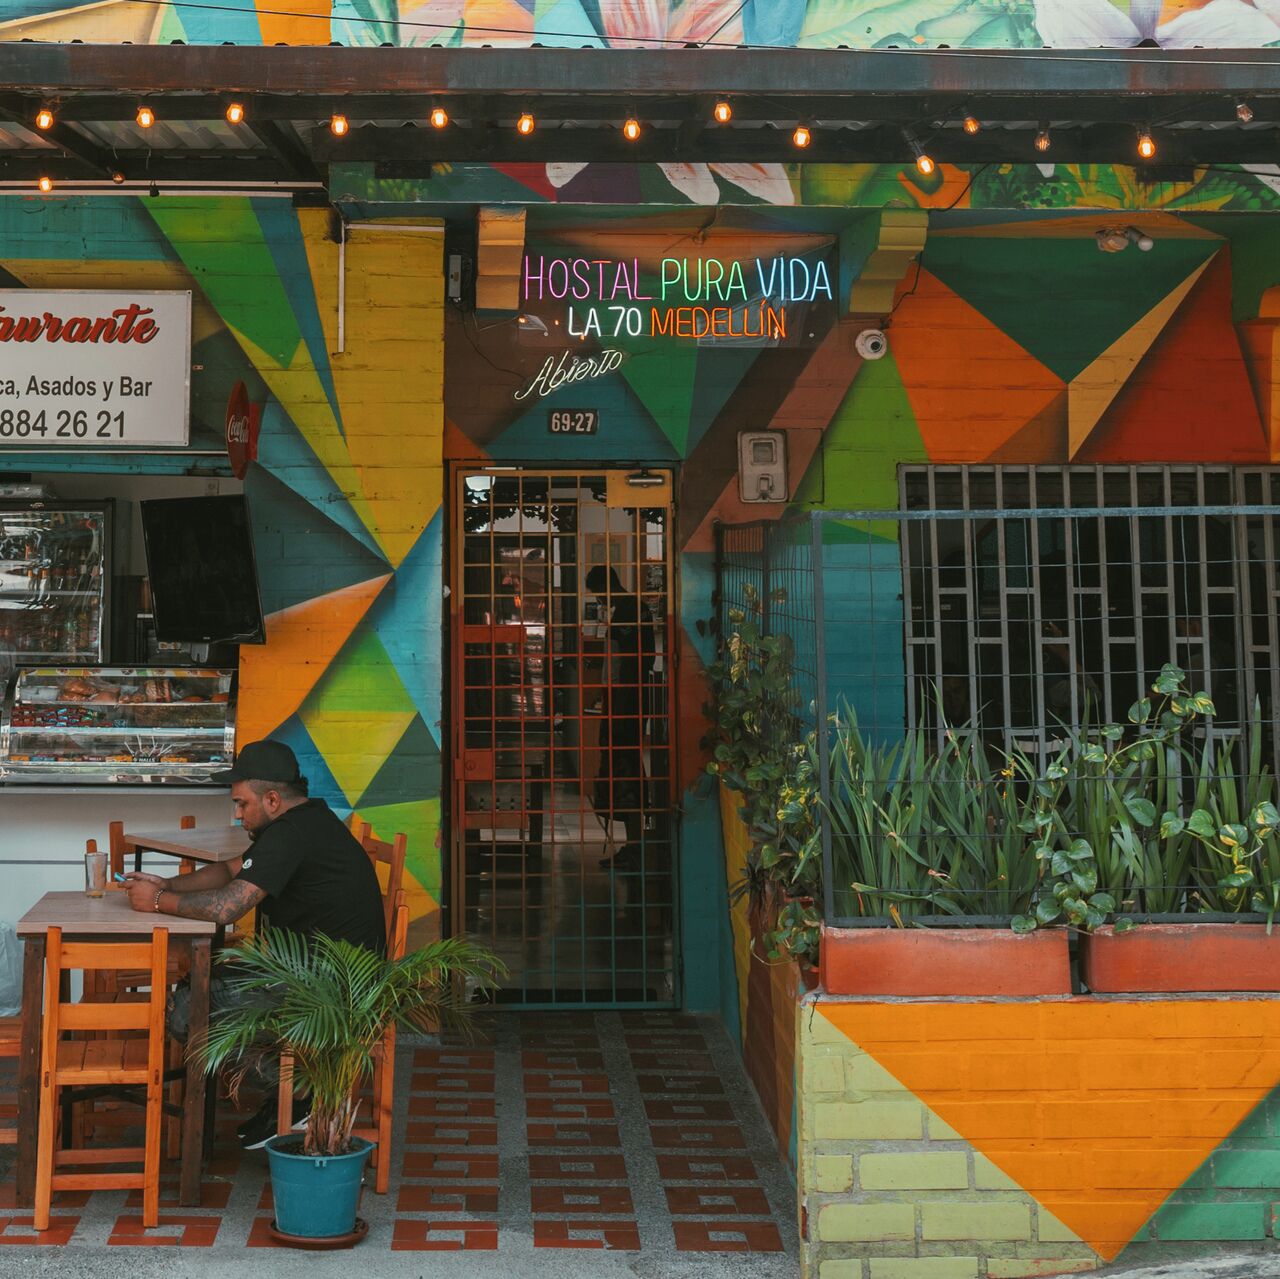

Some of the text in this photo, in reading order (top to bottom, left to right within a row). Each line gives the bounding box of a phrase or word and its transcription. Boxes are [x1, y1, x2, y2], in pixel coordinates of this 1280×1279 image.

[524, 254, 833, 301] HOSTAL PURA VIDA
[568, 299, 787, 339] LA 70 MEDELLÍN
[26, 375, 98, 398] Asados
[102, 380, 114, 402] y
[119, 376, 153, 399] Bar
[514, 347, 624, 400] Abierto
[56, 409, 88, 438] 26
[96, 410, 126, 438] 21
